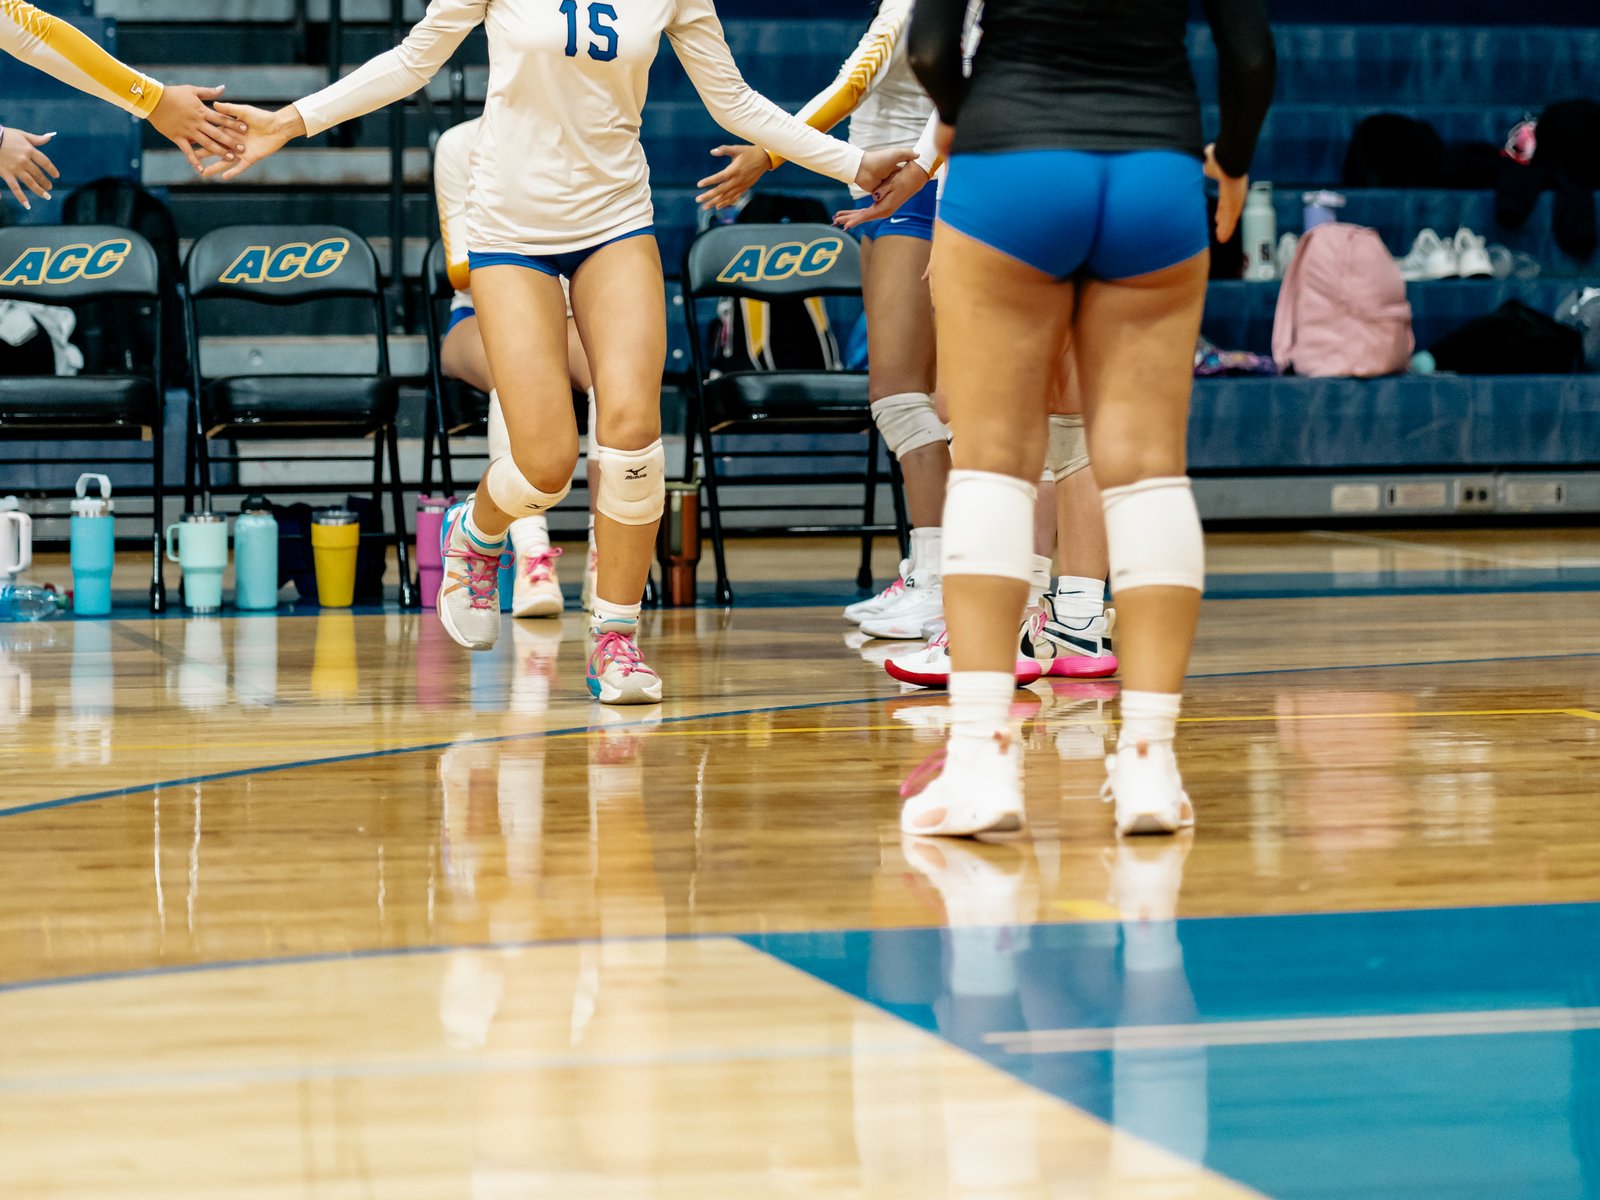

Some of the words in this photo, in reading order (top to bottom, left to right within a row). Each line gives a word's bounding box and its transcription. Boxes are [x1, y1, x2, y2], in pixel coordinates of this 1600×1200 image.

[0, 238, 131, 286] ACC
[218, 237, 350, 284] ACC
[716, 237, 844, 283] ACC
